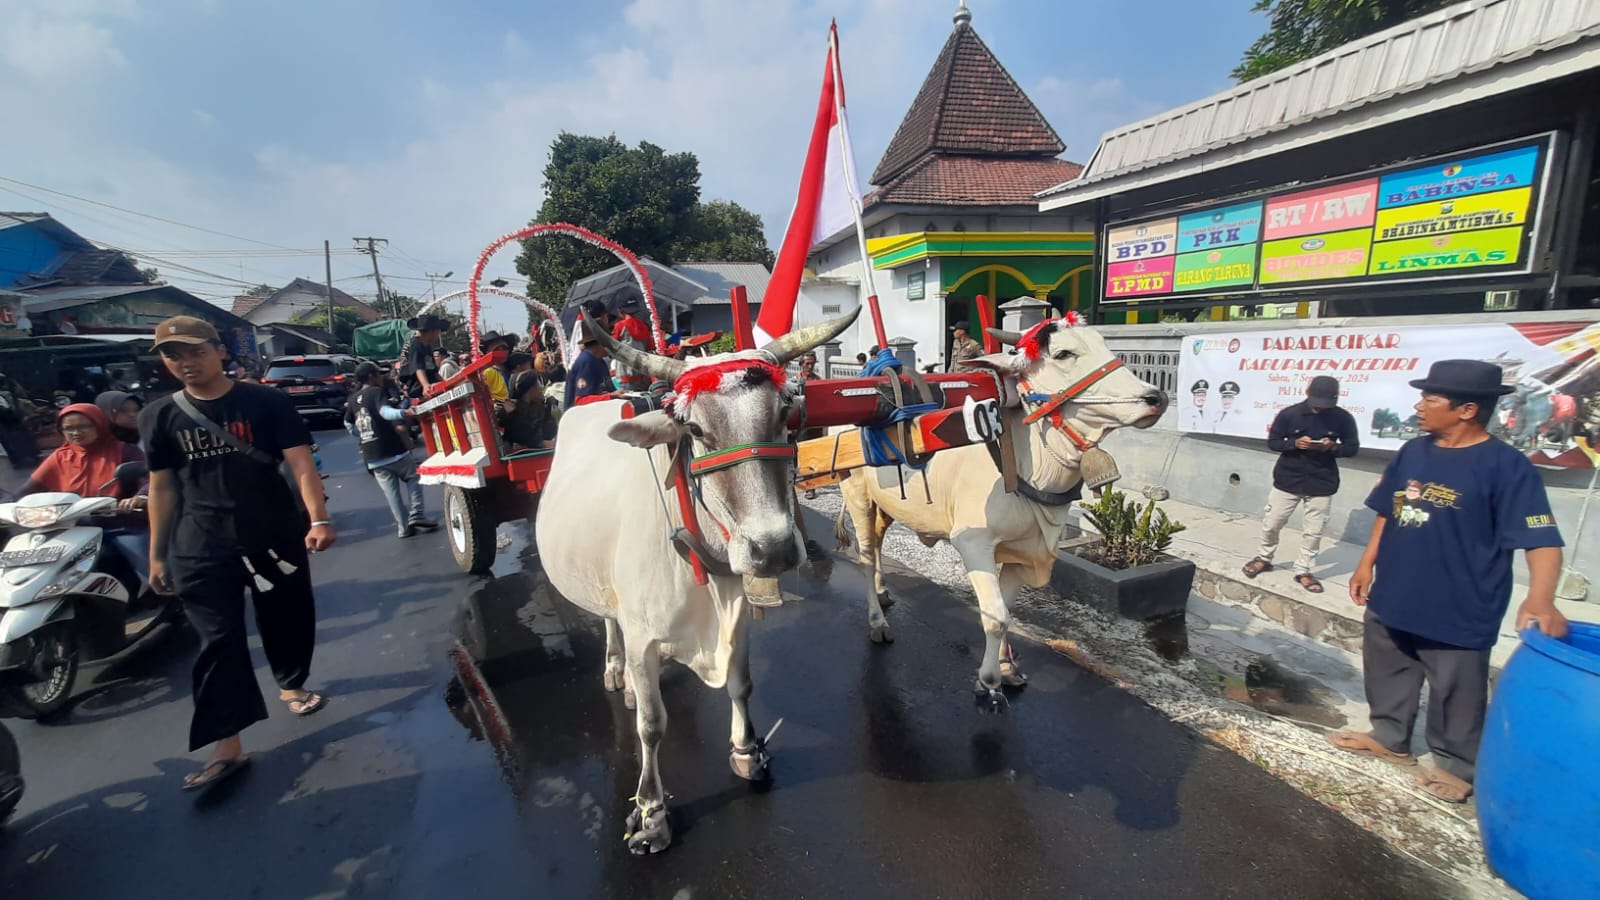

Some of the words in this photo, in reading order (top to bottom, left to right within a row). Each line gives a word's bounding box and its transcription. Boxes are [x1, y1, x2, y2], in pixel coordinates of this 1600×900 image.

[1387, 174, 1517, 203] BABINSA
[1268, 204, 1307, 229] RT
[1322, 191, 1372, 221] RW
[1382, 212, 1514, 238] BHABINKAMTIBMAS
[1193, 227, 1241, 248] PKK
[1116, 240, 1167, 259] BPD
[1265, 247, 1365, 272] BUMDES
[1377, 250, 1507, 271] LINMAS
[1176, 267, 1213, 286] KARANG
[1214, 262, 1251, 281] TARUNA
[1112, 277, 1165, 293] LPMD
[1262, 335, 1333, 351] PARADE
[1335, 333, 1401, 350] CIKAR
[1239, 358, 1338, 371] KABUPATEN
[1342, 357, 1420, 371] KEDIRI
[1347, 373, 1369, 383] 2024
[973, 401, 1005, 442] 03
